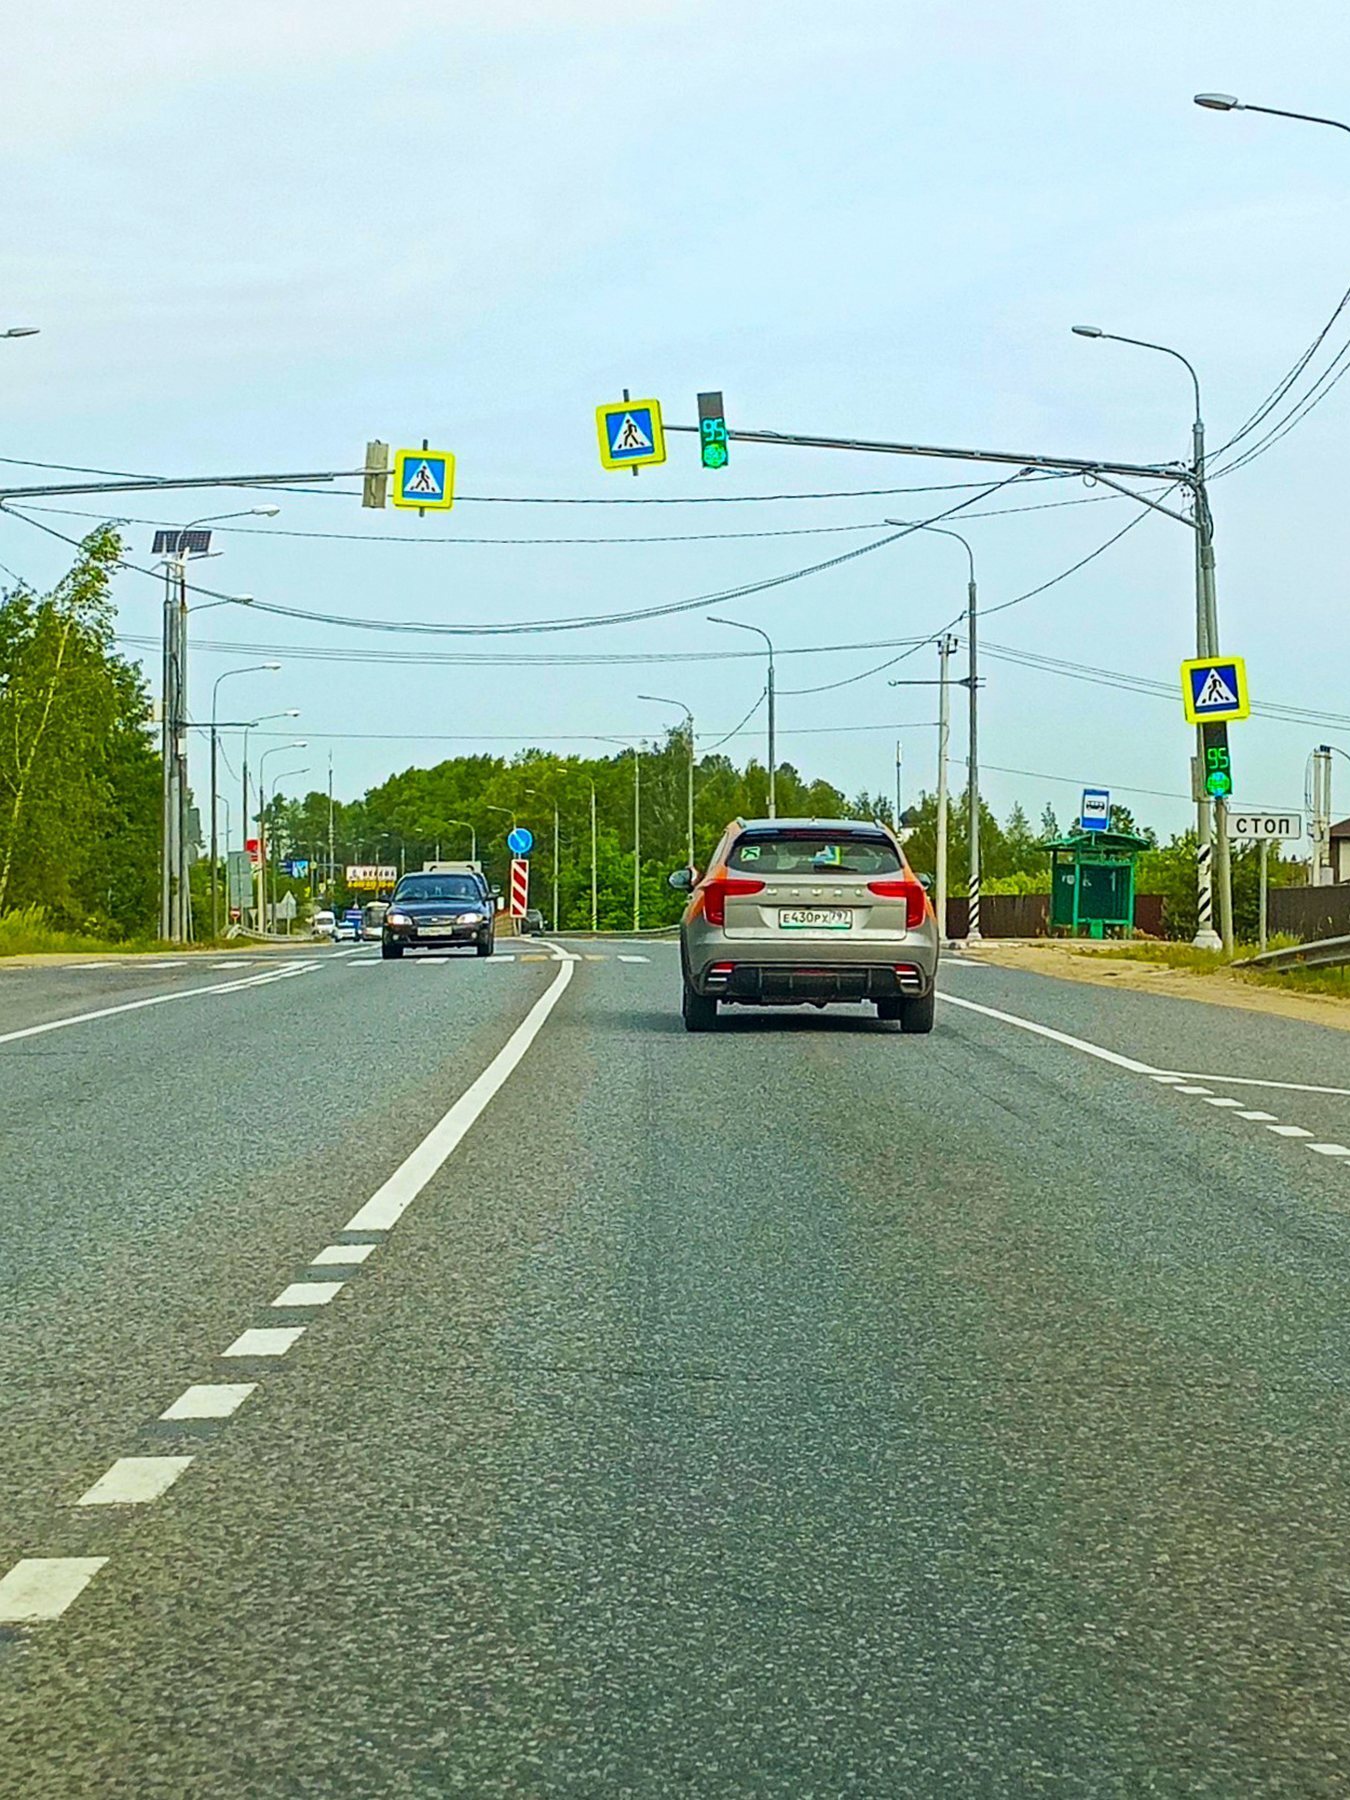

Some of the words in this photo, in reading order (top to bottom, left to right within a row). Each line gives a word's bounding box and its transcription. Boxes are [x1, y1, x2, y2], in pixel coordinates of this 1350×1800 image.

[702, 418, 726, 442] 95
[1207, 747, 1229, 770] 95
[1236, 818, 1290, 835] СТОП
